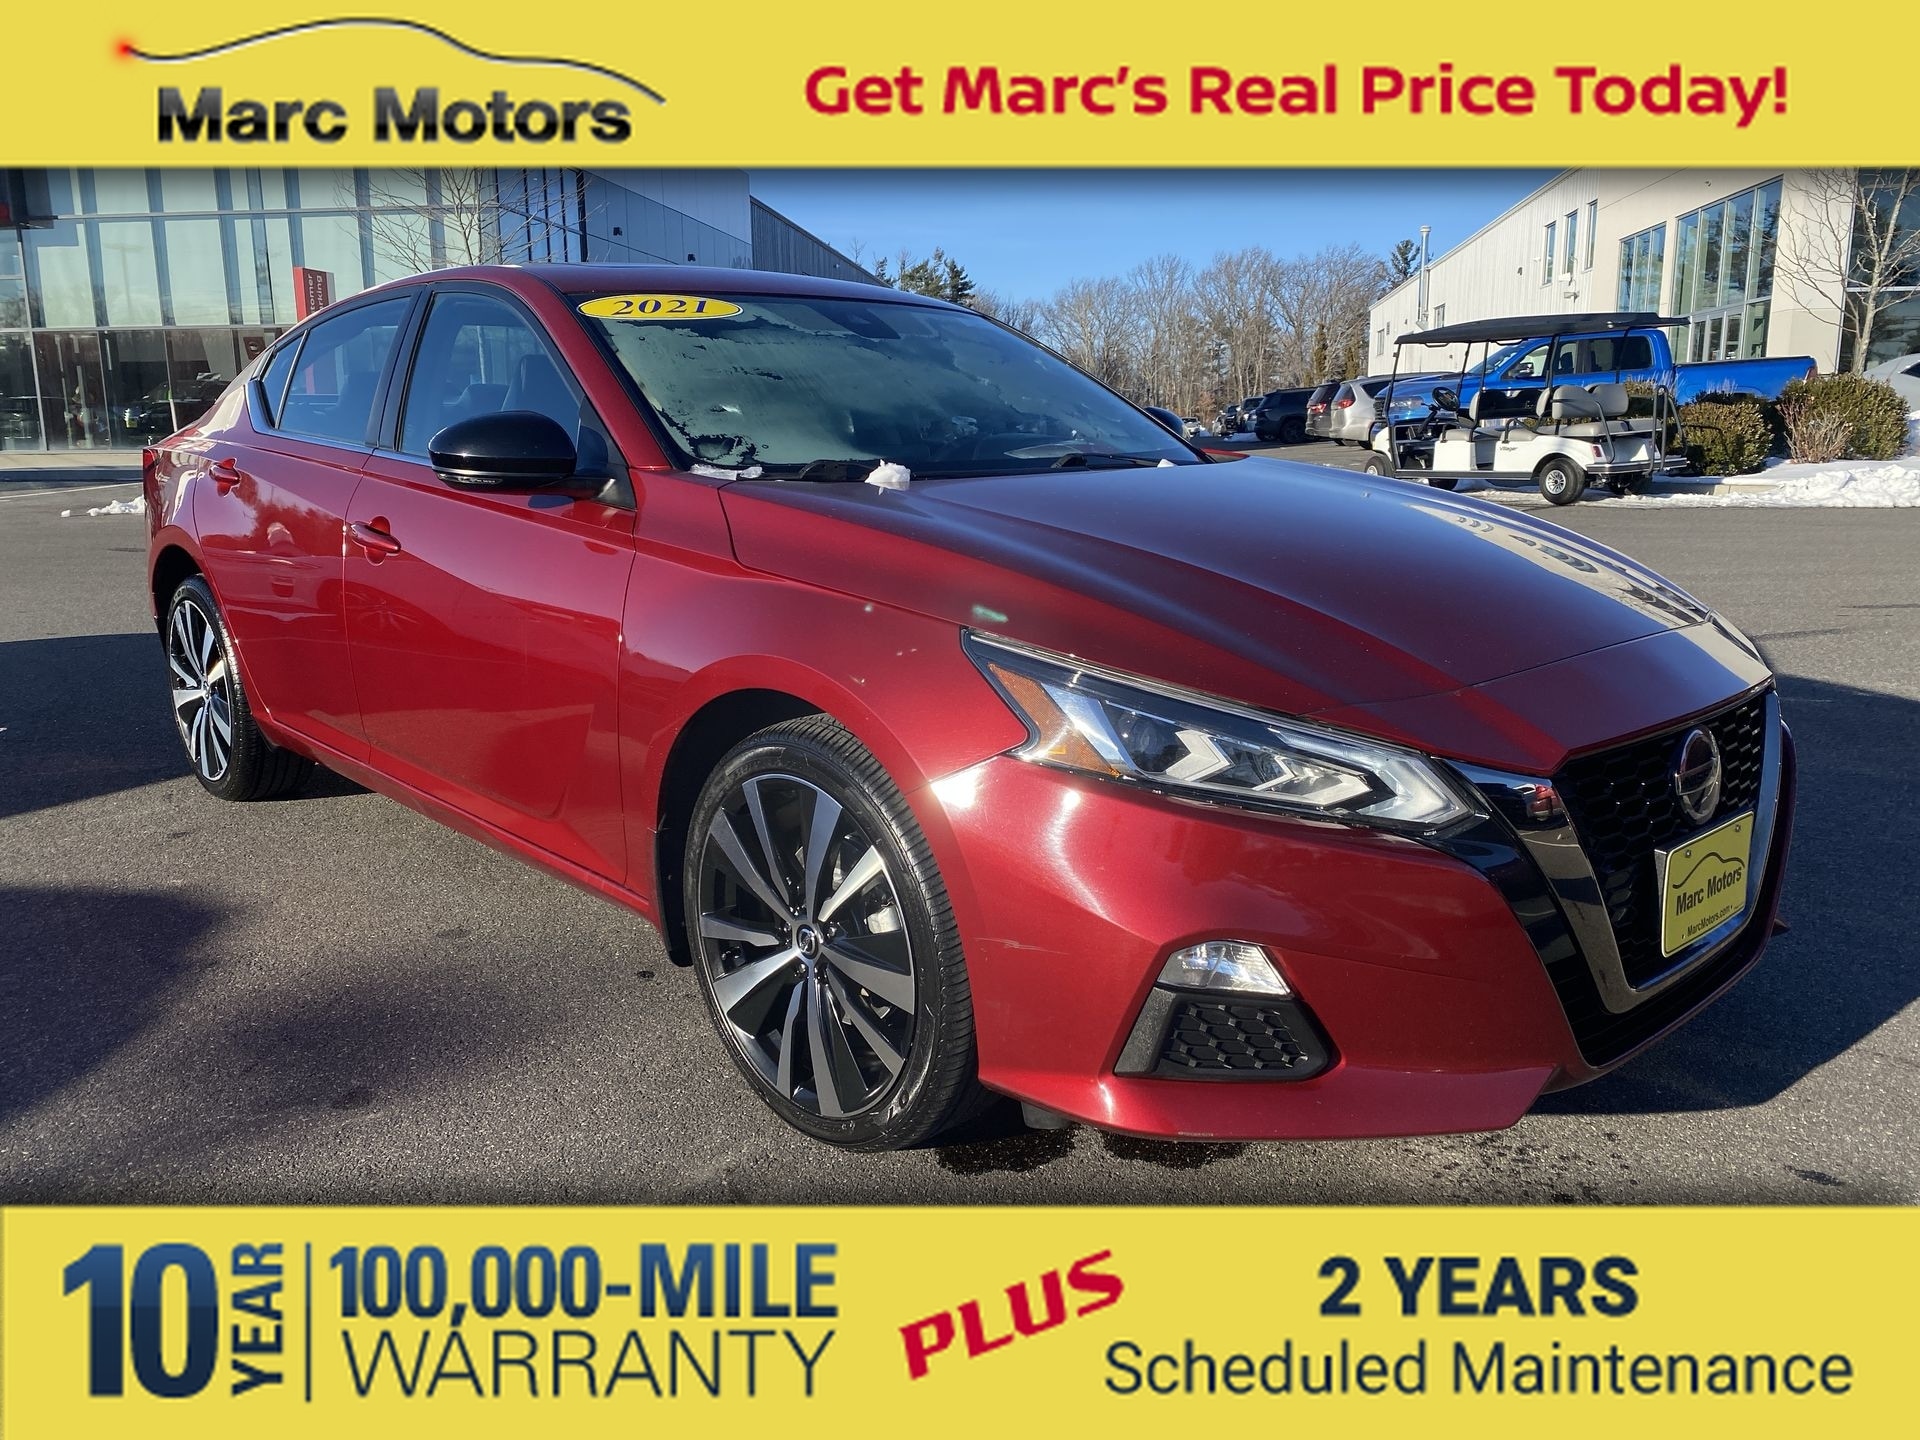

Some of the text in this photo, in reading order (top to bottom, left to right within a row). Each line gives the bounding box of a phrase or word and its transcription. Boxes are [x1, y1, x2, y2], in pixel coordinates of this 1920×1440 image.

[611, 299, 708, 316] 2021
[1676, 867, 1742, 916] Marc Motors
